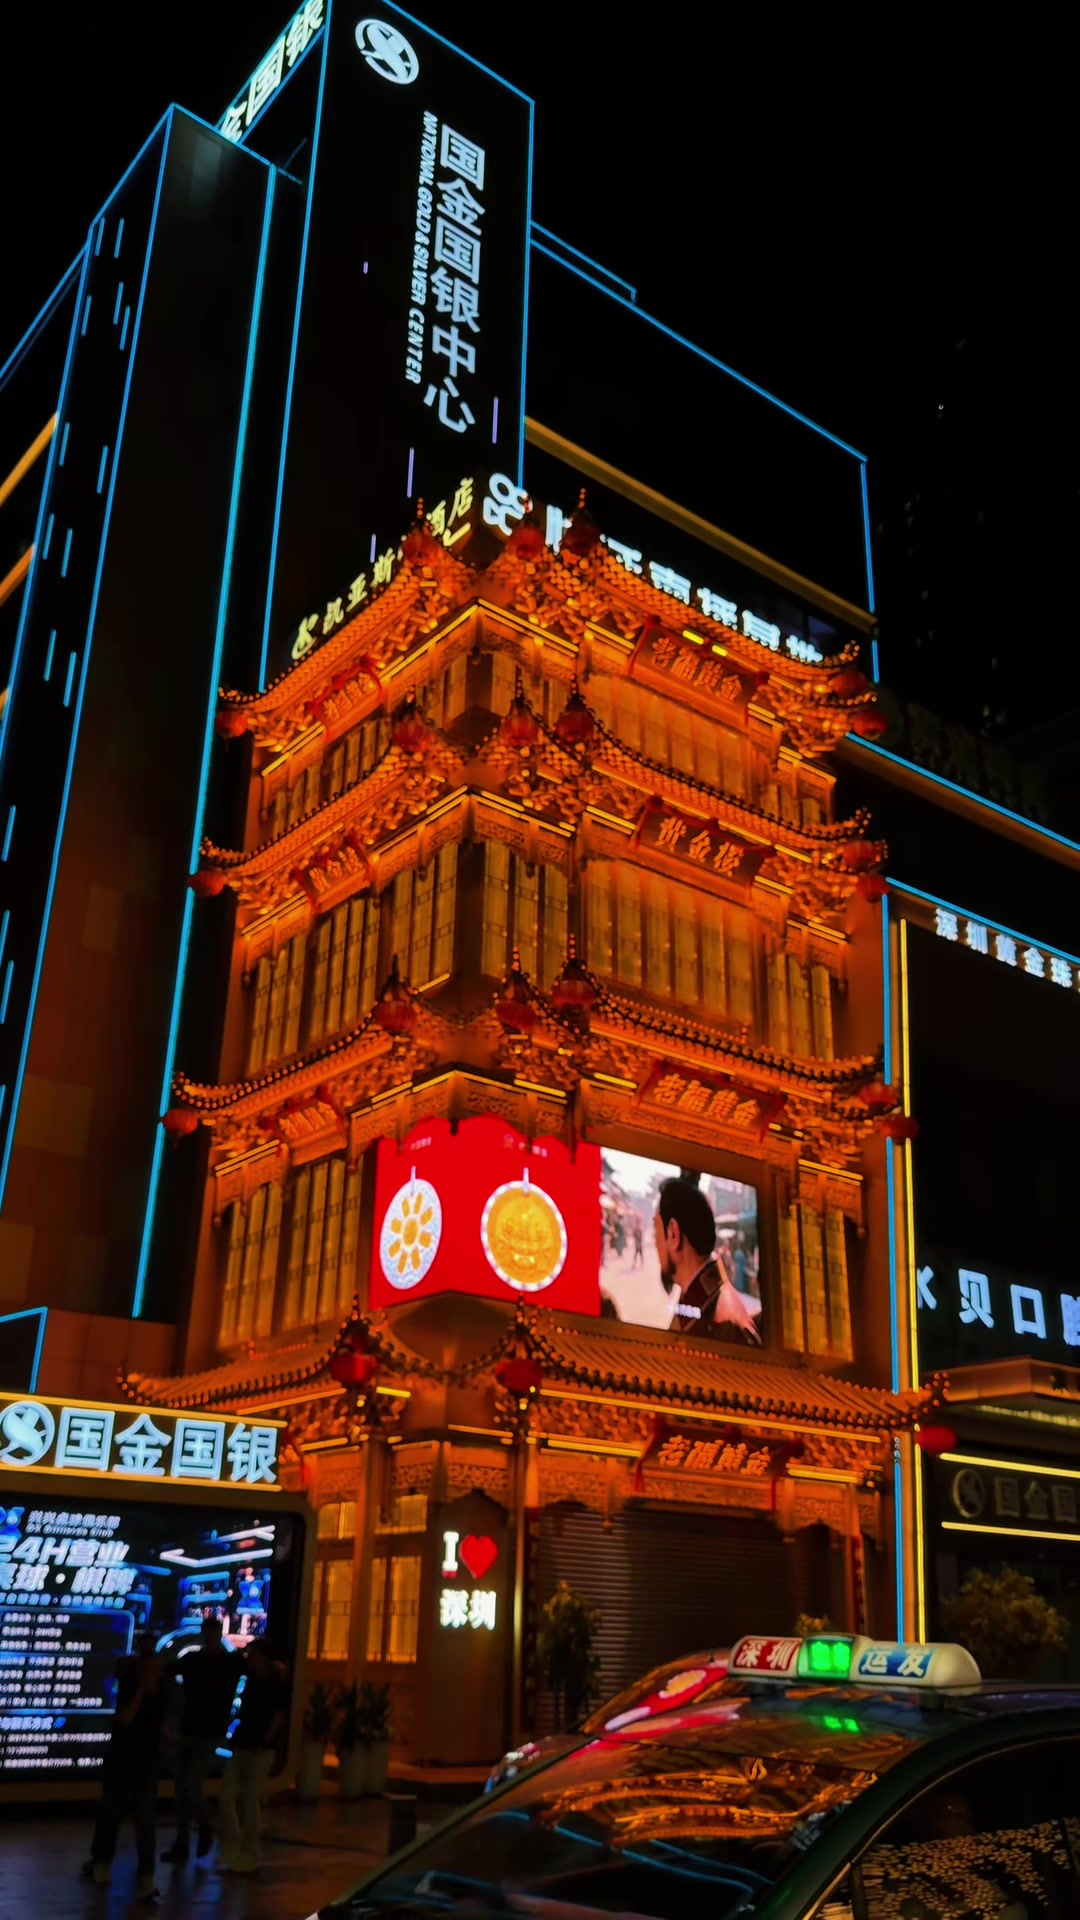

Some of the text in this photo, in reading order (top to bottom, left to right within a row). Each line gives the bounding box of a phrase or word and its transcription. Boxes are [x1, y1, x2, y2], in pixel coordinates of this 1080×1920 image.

[405, 111, 438, 385] NATIONAL GOLD&SILVER CENTER
[423, 123, 486, 434] 国金国银中心
[55, 1406, 278, 1483] 国金国银
[442, 1531, 459, 1573] I
[440, 1588, 497, 1630] 深圳
[736, 1639, 800, 1669] 深圳
[861, 1646, 931, 1677] 运发
